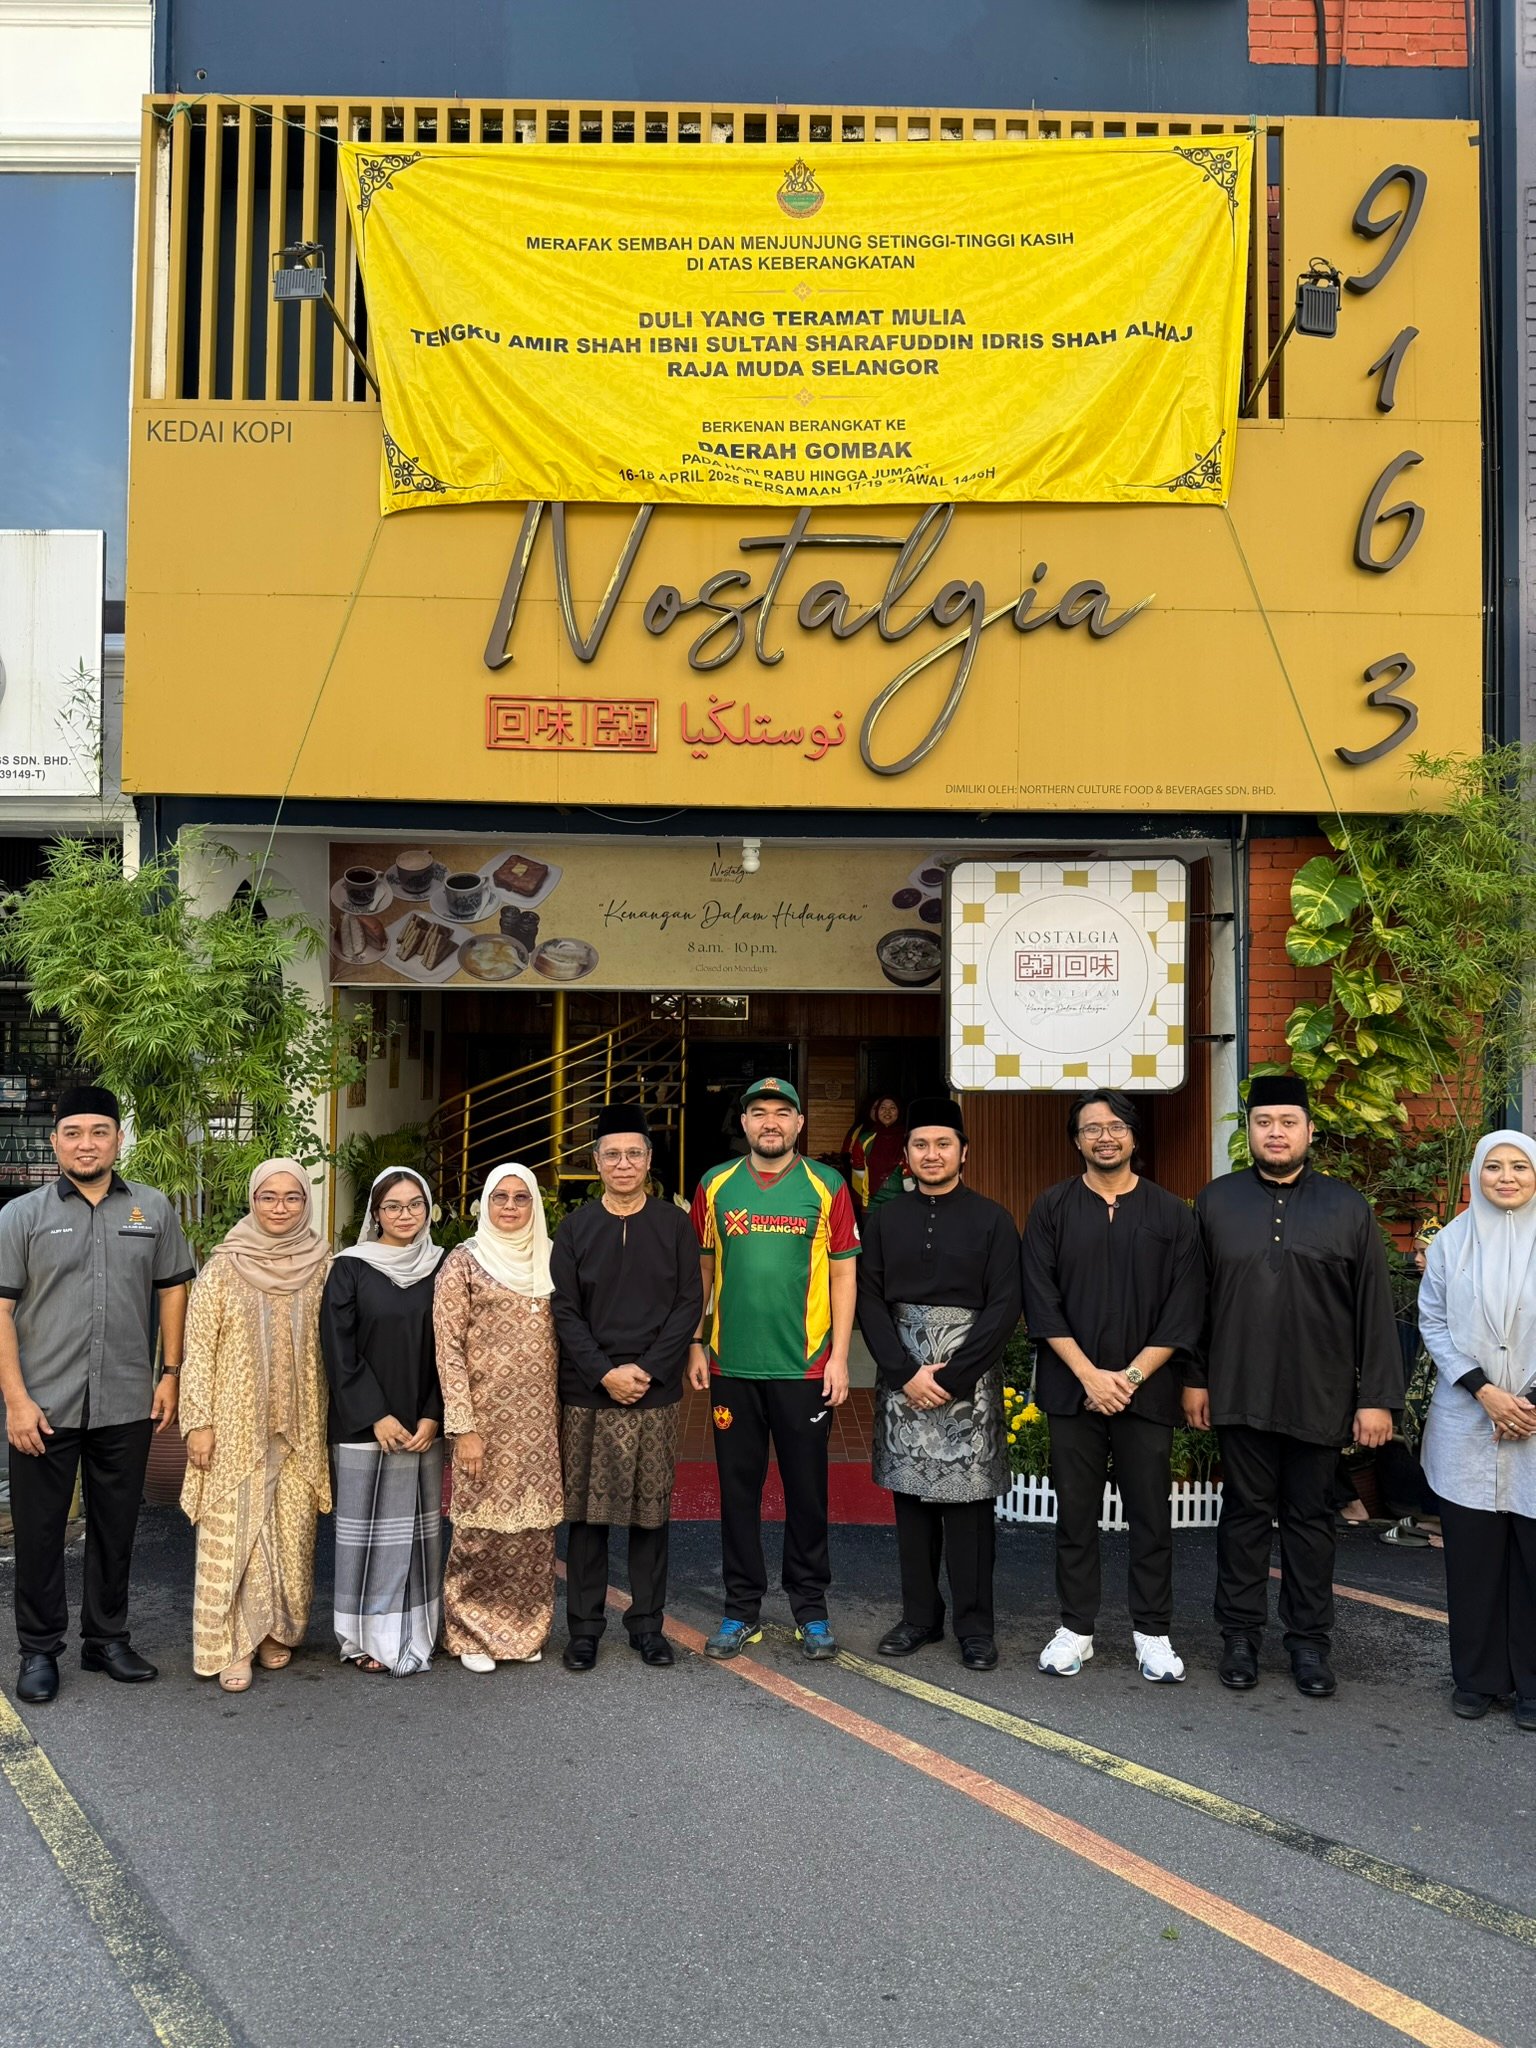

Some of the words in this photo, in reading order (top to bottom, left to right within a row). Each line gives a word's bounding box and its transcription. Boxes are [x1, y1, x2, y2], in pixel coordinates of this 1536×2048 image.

[526, 236, 613, 252] MERAFAK
[617, 236, 693, 251] SEMBAH
[698, 236, 736, 251] DAN
[741, 234, 862, 250] MENJUNJUNG
[867, 233, 1015, 250] SETINGGI-TINGGI
[1020, 231, 1074, 247] KASIH
[686, 256, 704, 271] DI
[707, 256, 753, 271] ATAS
[758, 254, 915, 271] KEBERANGKATAN
[638, 311, 693, 329] DULI
[700, 310, 765, 328] YANG
[773, 309, 885, 327] TERAMAT
[892, 308, 967, 326] MULIA
[410, 322, 501, 348] TENGKU
[507, 335, 569, 354] AMIR
[576, 337, 641, 354] SHAH
[649, 336, 698, 353] IBNI
[705, 335, 798, 353] SULTAN
[805, 333, 974, 352] SHARAFUDDIN
[982, 332, 1044, 350] IDRIS
[1051, 328, 1117, 349] SHAH
[1124, 320, 1193, 343] ALHAJ
[667, 361, 730, 378] RAJA
[736, 360, 805, 377] MUDA
[811, 358, 940, 377] SELANGOR
[147, 419, 224, 443] KEDAI
[233, 420, 292, 444] KOPI
[702, 420, 785, 433] BERKENAN
[789, 419, 882, 432] BERANGKAT
[886, 418, 906, 431] KE
[697, 441, 797, 460] DAERAH
[804, 441, 913, 460] GOMBAK
[659, 469, 704, 484] APRIL
[682, 453, 722, 468] PADA
[763, 469, 806, 482] RABU
[810, 469, 868, 482] HINGGA
[483, 500, 1158, 777] Nostalgia
[493, 702, 574, 745] 回味
[0, 755, 10, 766] S
[12, 755, 40, 766] SDN.
[43, 755, 72, 766] BHD.
[944, 784, 986, 795] DIMILIKI
[987, 784, 1017, 795] OLEH:
[1019, 784, 1074, 795] NORTHERN
[1076, 784, 1121, 795] CULTURE
[1123, 784, 1154, 795] FOOD
[1155, 785, 1163, 795] &
[1165, 785, 1223, 796] BEVERAGES
[1224, 785, 1250, 796] SDN.
[1251, 785, 1276, 796] BHD.
[709, 861, 755, 885] Nostalg
[700, 899, 767, 930] Dalam
[1014, 930, 1119, 944] NOSTALGIA
[686, 941, 696, 954] 8
[697, 942, 724, 954] a.m.
[734, 941, 748, 954] 10
[750, 943, 777, 957] p.m.
[695, 963, 722, 973] Closed
[723, 965, 733, 973] on
[734, 963, 768, 974] Mondays
[1064, 953, 1114, 979] 回味
[750, 1223, 807, 1235] SELANGOR
[751, 1214, 807, 1228] RUMPUN
